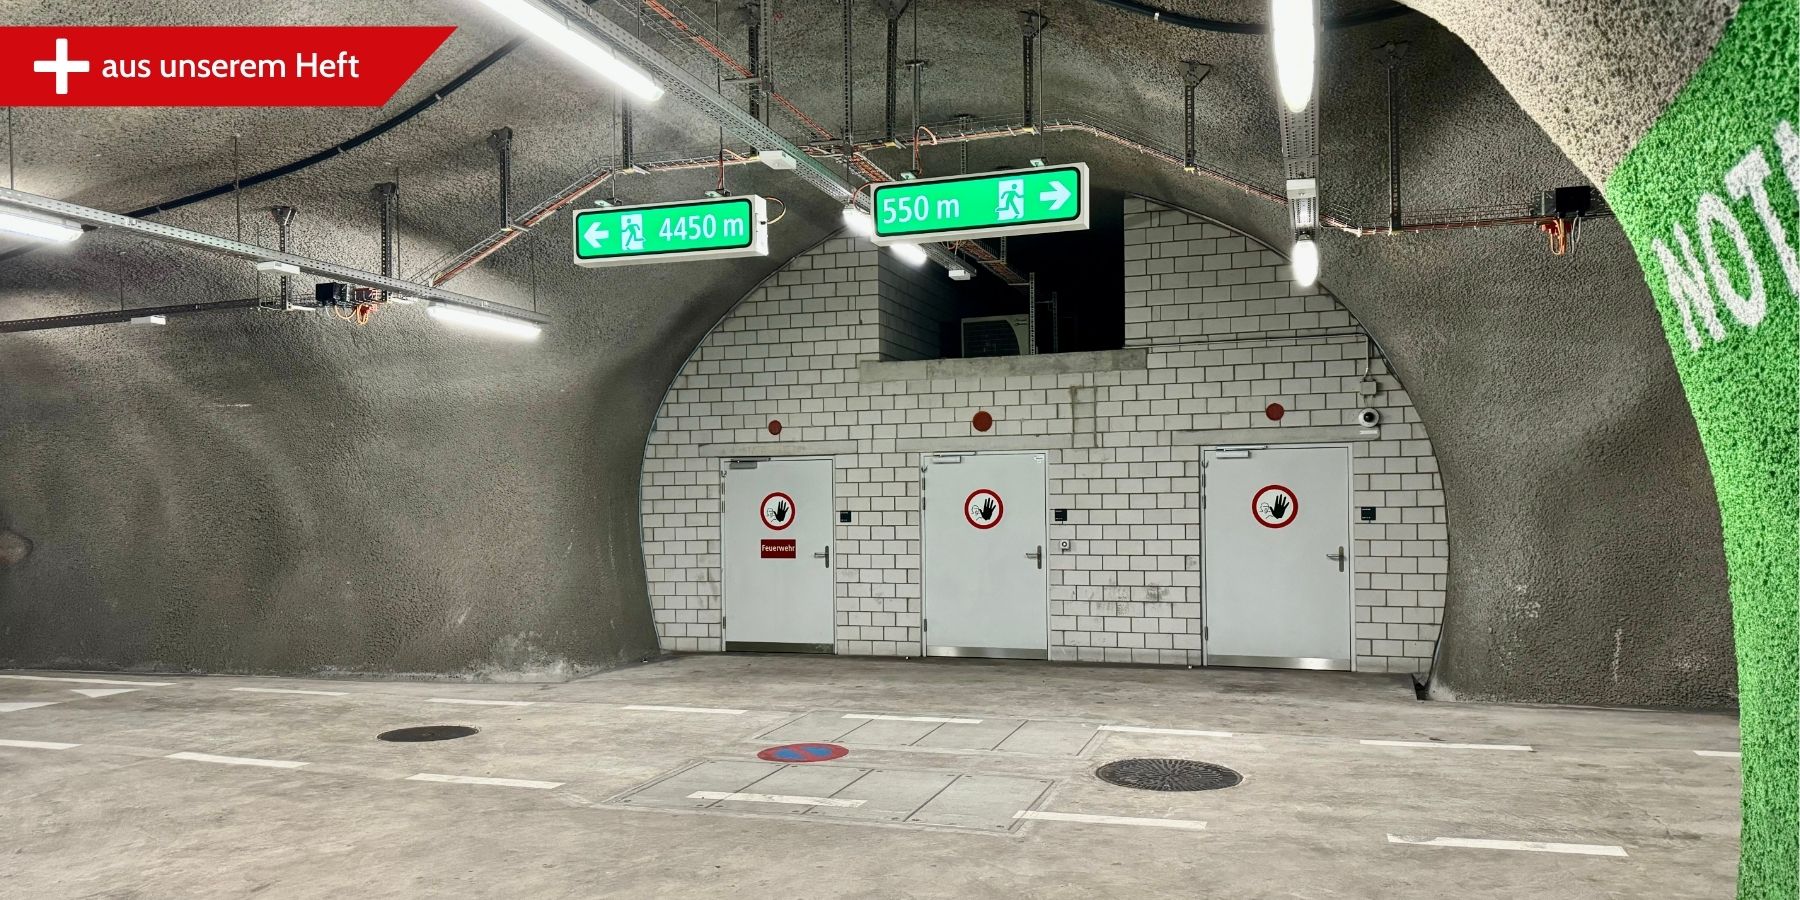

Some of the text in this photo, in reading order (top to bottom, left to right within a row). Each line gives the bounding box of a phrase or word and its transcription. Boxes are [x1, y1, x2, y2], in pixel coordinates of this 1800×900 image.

[883, 195, 960, 224] 550 m
[658, 213, 744, 241] 4450 m
[1650, 119, 1800, 353] NOT
[761, 544, 795, 552] Feuerwehr
